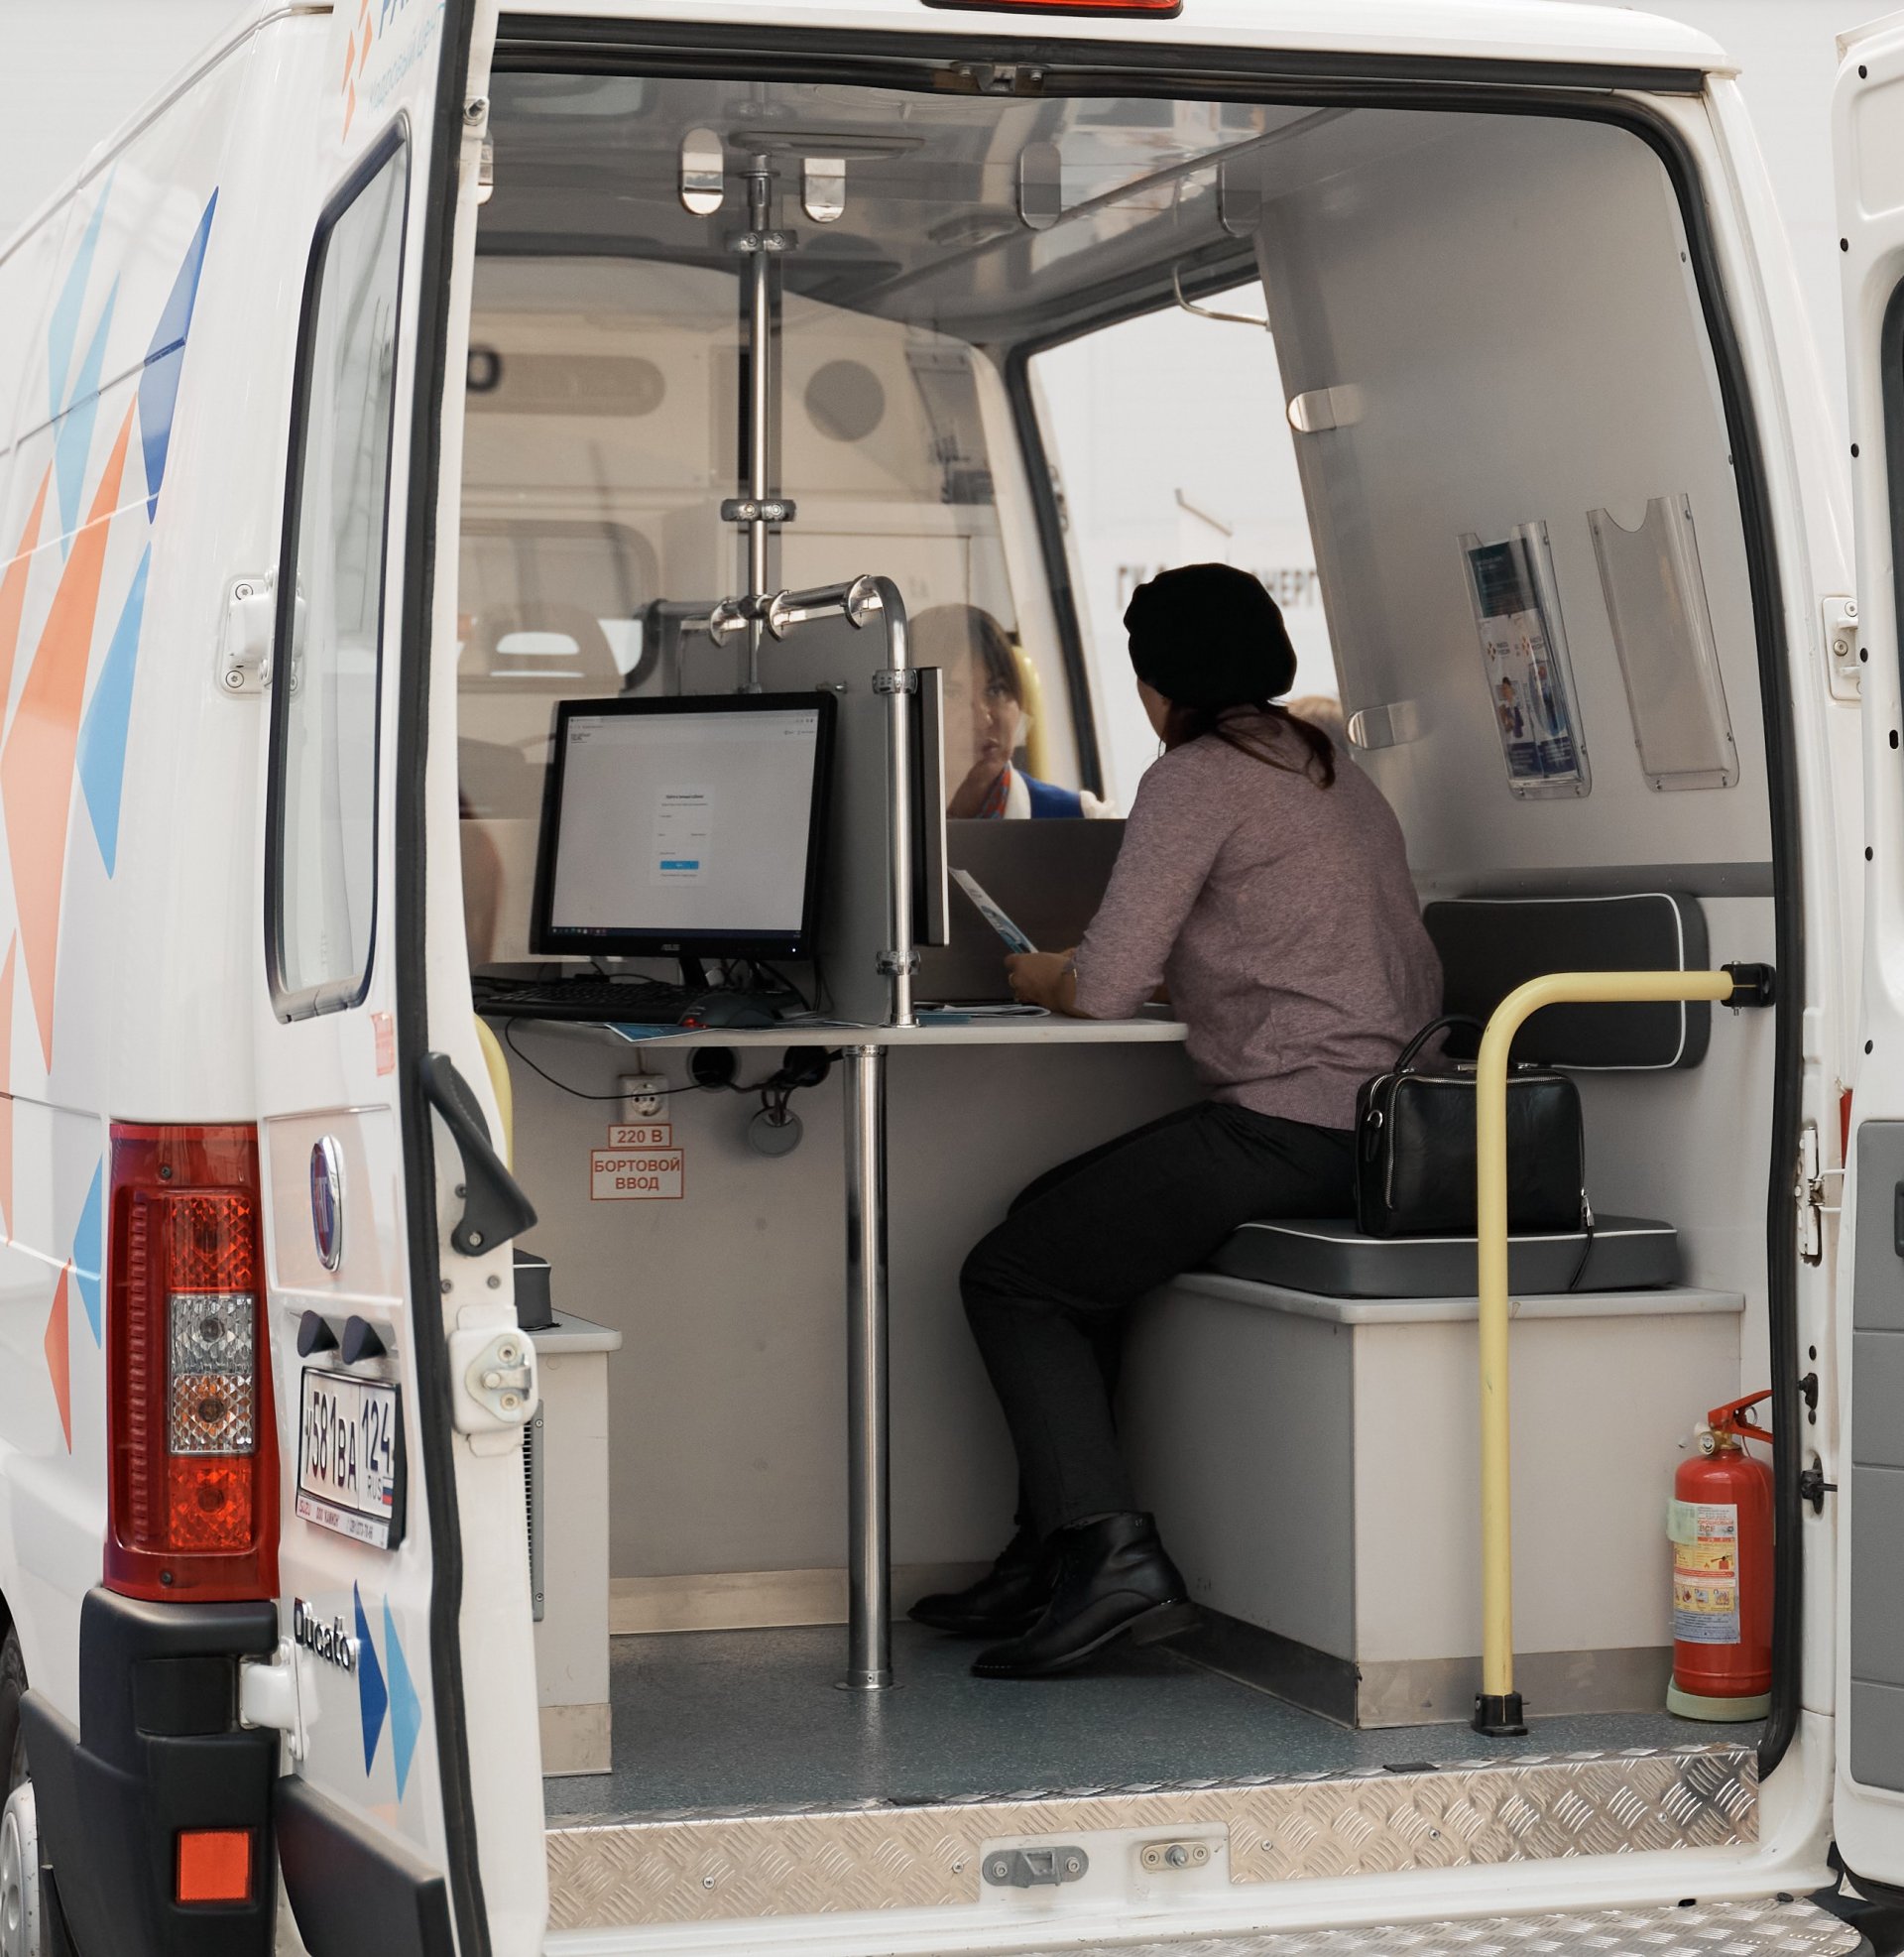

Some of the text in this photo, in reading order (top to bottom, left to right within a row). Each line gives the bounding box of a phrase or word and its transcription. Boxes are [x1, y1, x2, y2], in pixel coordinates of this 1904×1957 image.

[617, 1129, 663, 1144] 220 В
[594, 1157, 680, 1172] БОРТОВОЙ
[615, 1177, 659, 1191] ВВОД
[361, 1398, 391, 1474] 124
[367, 1474, 382, 1502] RUS
[294, 1596, 357, 1673] Ducato
